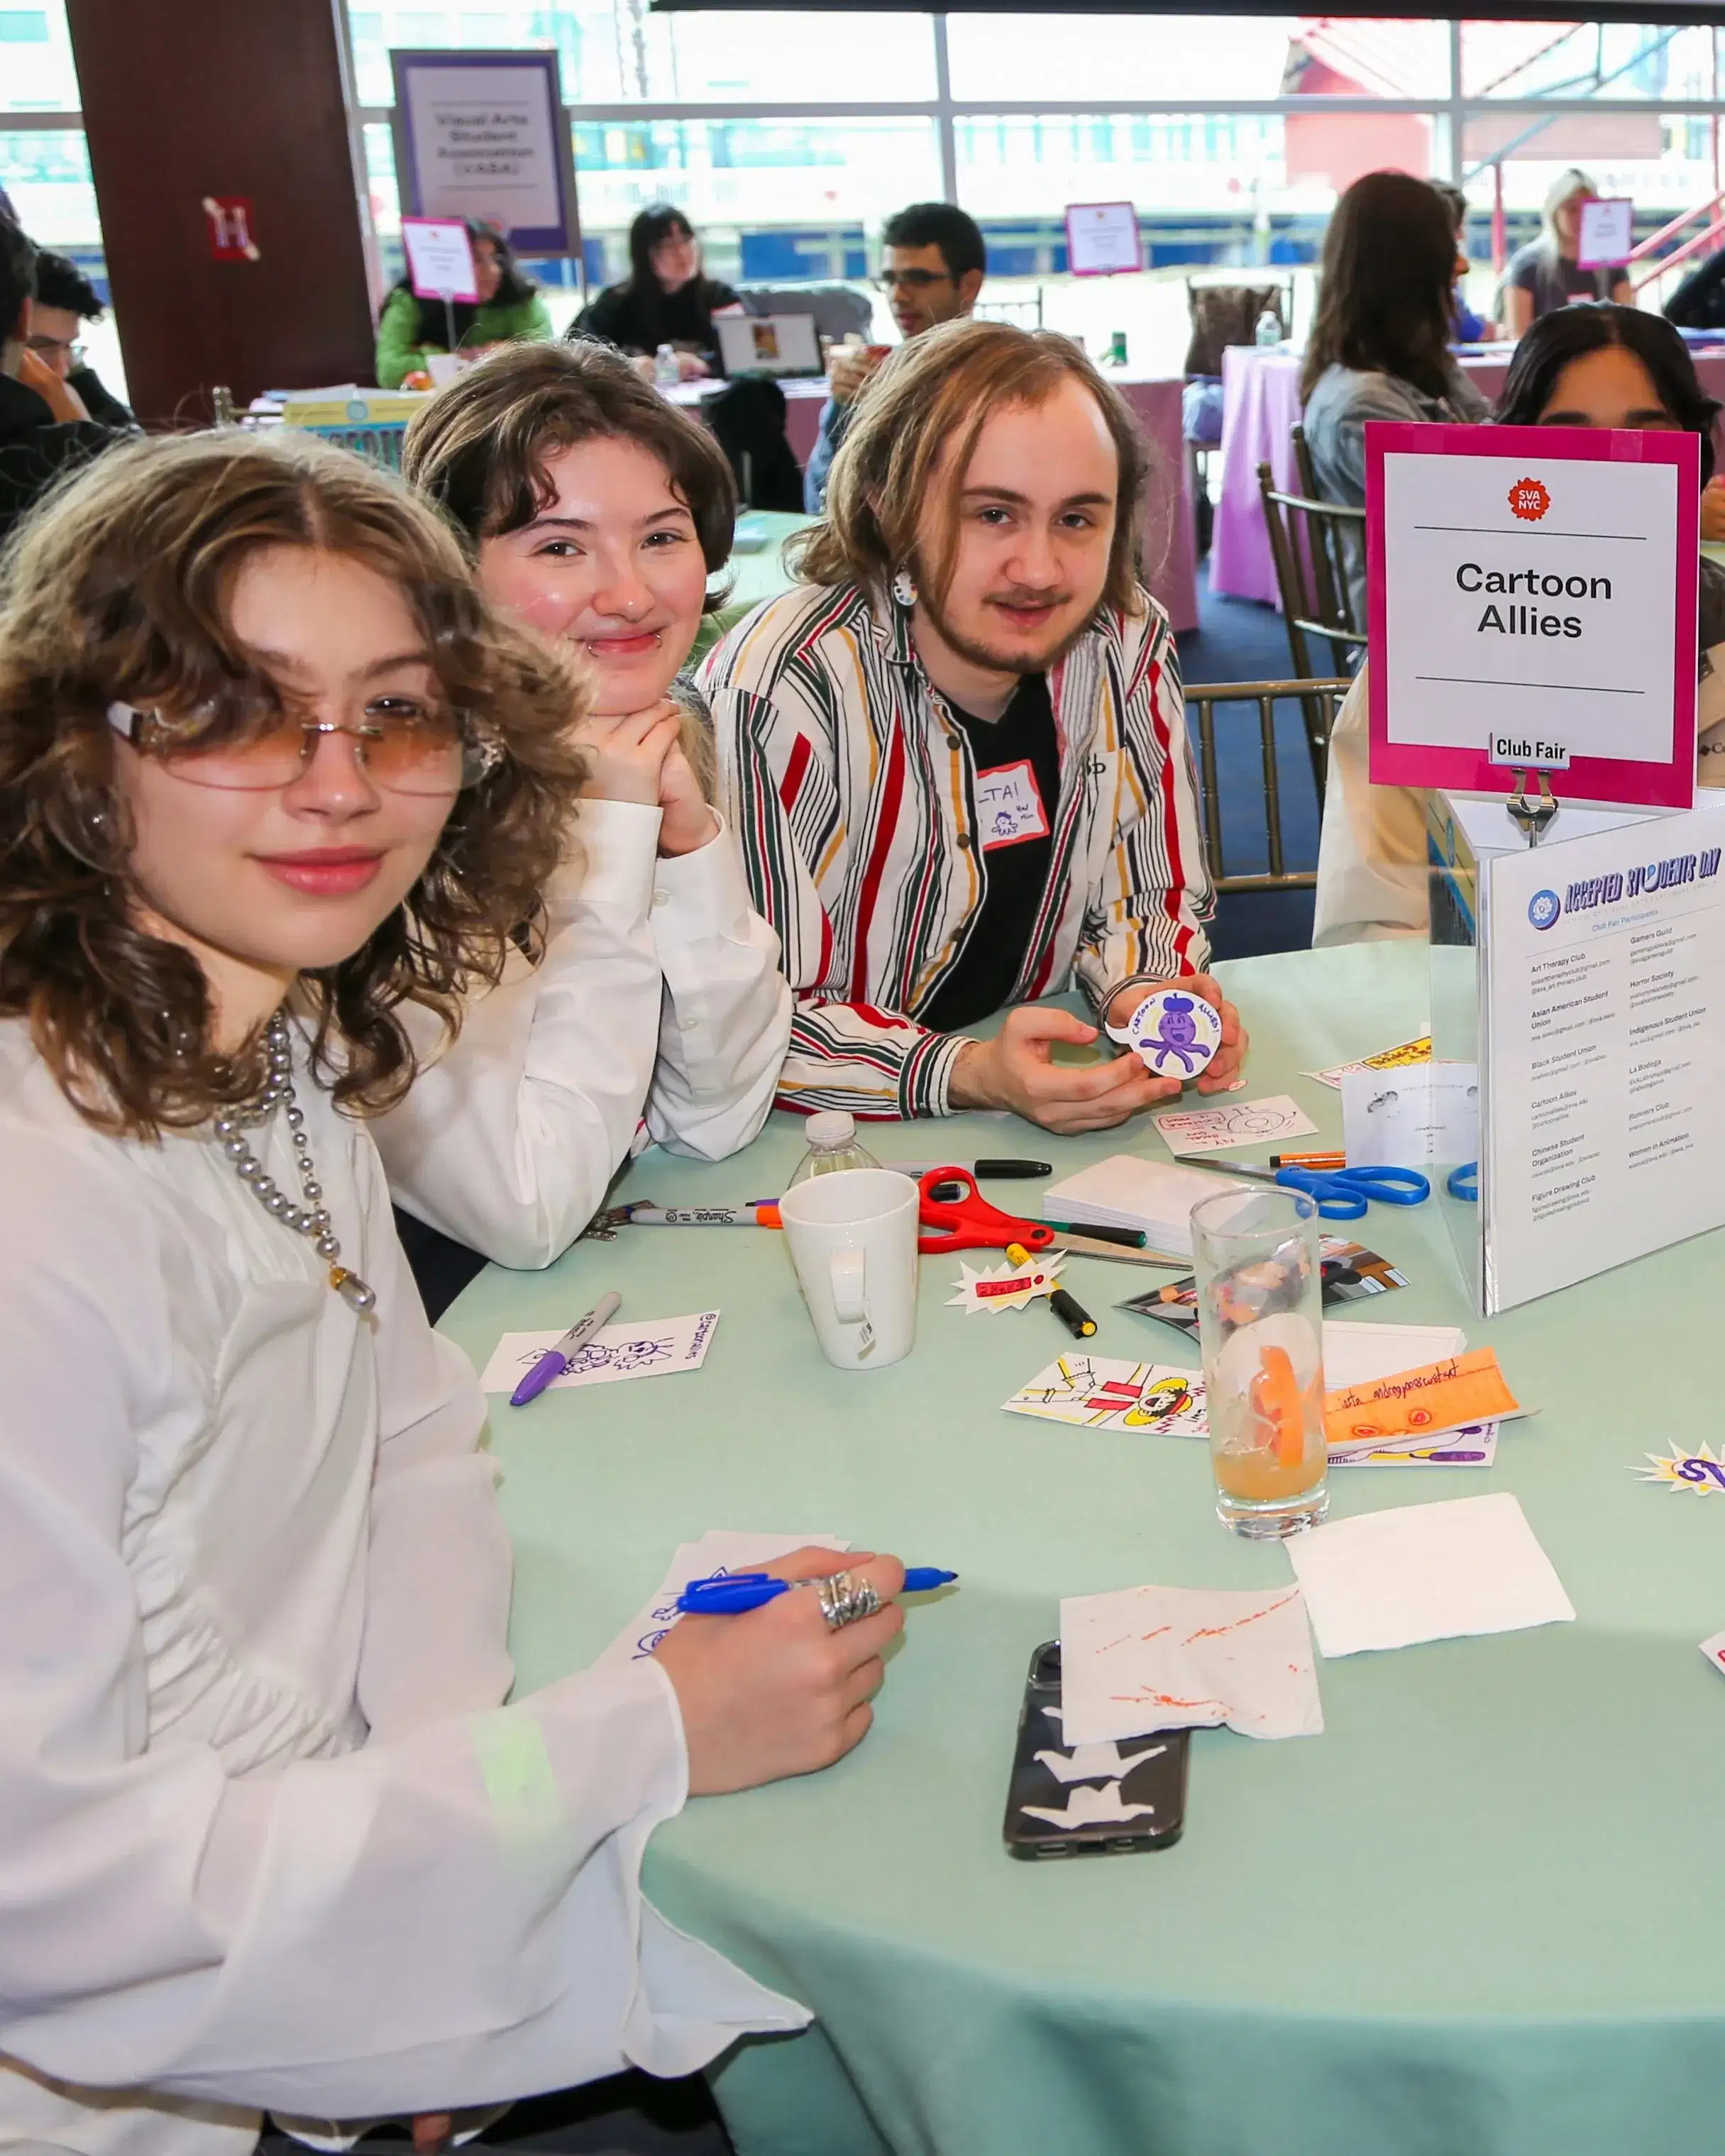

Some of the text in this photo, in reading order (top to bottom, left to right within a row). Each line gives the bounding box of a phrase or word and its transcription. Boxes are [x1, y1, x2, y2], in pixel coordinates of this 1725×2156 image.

[1519, 490, 1541, 500] SVA
[1519, 500, 1541, 510] NYC
[1456, 563, 1611, 599] Cartoon
[1477, 604, 1582, 638] Allies
[1497, 739, 1565, 760] Club Fair
[1565, 873, 1624, 913] ACCEPTED
[1626, 853, 1697, 897] STUDENTS
[1699, 847, 1721, 879] DAY
[1592, 922, 1606, 932] Club
[1608, 917, 1619, 928] Fair
[1630, 927, 1672, 944] Gamers Guild
[1543, 958, 1569, 970] Therapy
[1570, 953, 1586, 962] Club
[1630, 971, 1674, 988] Horror Society
[1531, 991, 1608, 1018] Asian American Student
[1531, 1019, 1551, 1029] Union
[1630, 1020, 1663, 1036] Indigenous
[1665, 1012, 1688, 1025] Student
[1689, 1007, 1706, 1017] Union
[1532, 1045, 1597, 1069] Black Student Union
[1532, 1090, 1577, 1109] Cartoon Allies
[1628, 1107, 1654, 1121] Runners
[1655, 1102, 1669, 1112] Club
[1532, 1134, 1585, 1156] Chinese Student
[1628, 1145, 1652, 1158] Women
[1659, 1132, 1689, 1147] Animation
[1532, 1149, 1573, 1167] Organization
[1532, 1190, 1553, 1202] Figure
[1553, 1180, 1580, 1194] Drawing
[1581, 1175, 1596, 1185] Club
[693, 1210, 736, 1225] Sharpie
